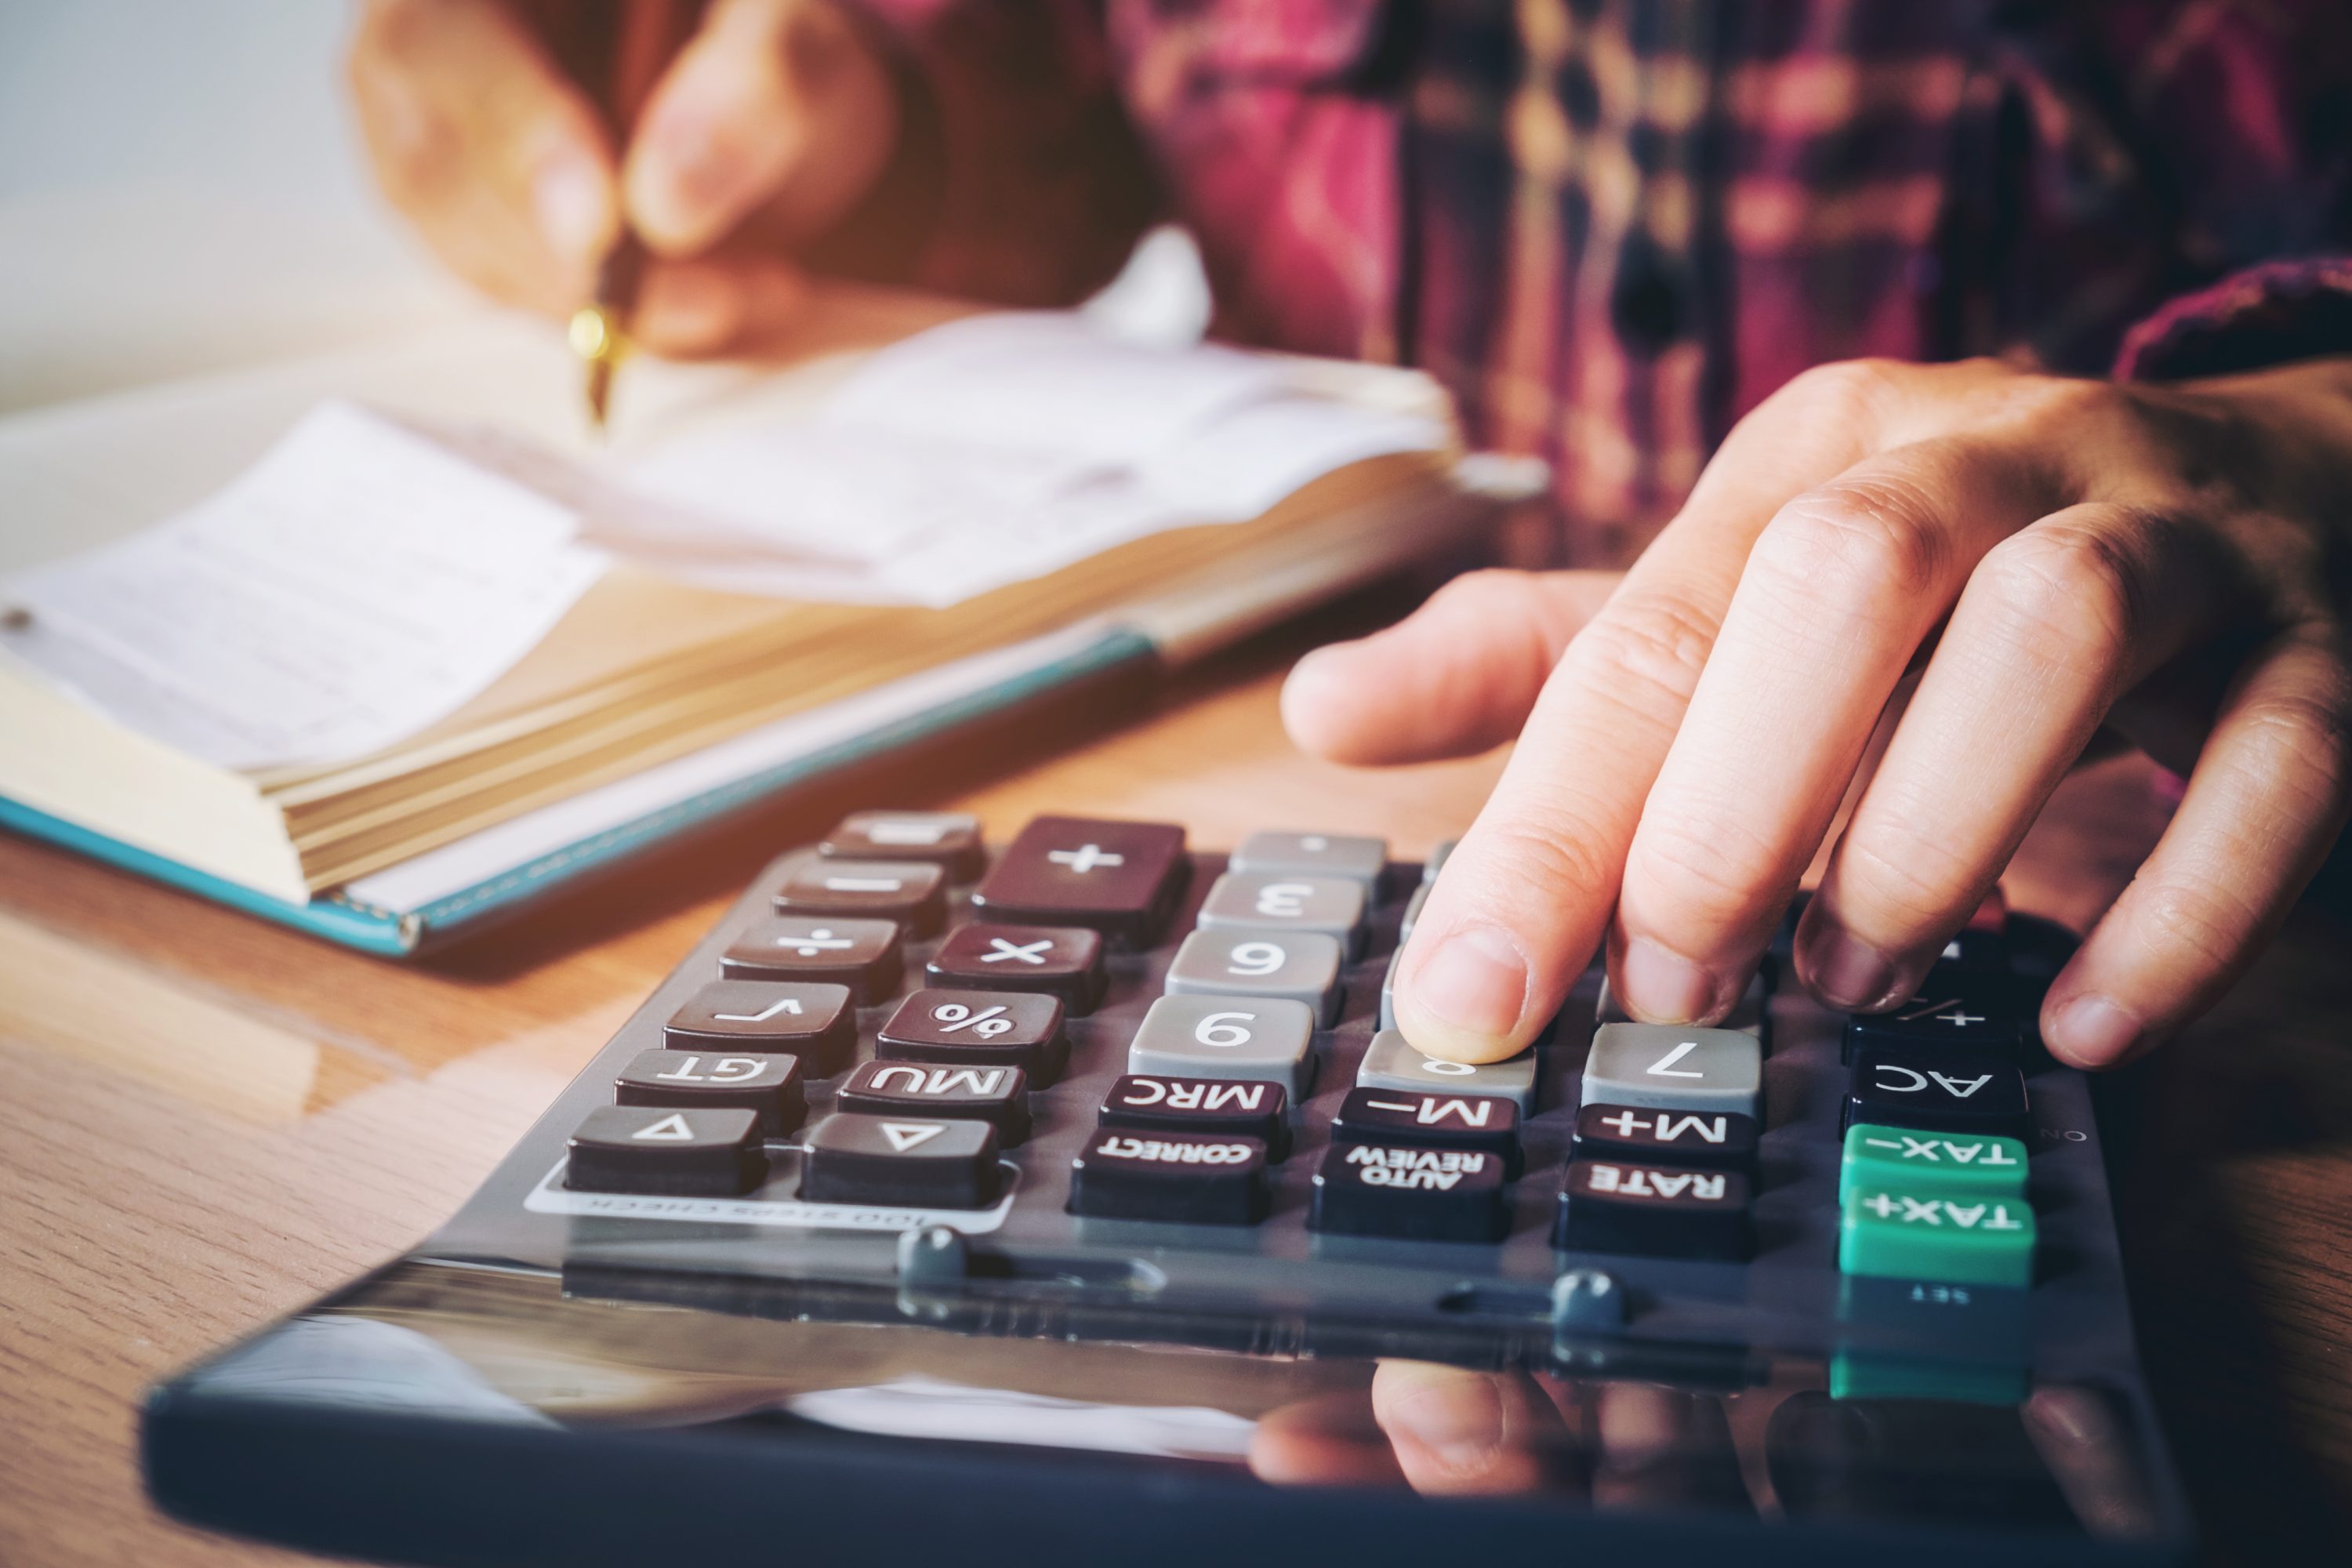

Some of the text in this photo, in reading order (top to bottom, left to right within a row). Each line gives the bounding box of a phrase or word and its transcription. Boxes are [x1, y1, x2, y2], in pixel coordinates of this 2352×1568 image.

[1256, 884, 1313, 916] 3
[1228, 942, 1286, 975] 6
[934, 1004, 1011, 1034] %
[1196, 1012, 1256, 1047] 9
[657, 1056, 768, 1081] GT
[1647, 1042, 1703, 1078] 7
[870, 1067, 1001, 1094] MU
[1123, 1080, 1265, 1109] MRC
[1875, 1065, 1993, 1097] AC
[1602, 1111, 1726, 1142] M+
[2041, 1128, 2087, 1142] ON
[1097, 1137, 1252, 1163] CORRECT
[1345, 1145, 1484, 1173] REVIEW
[1360, 1165, 1463, 1190] AUTO
[1588, 1164, 1726, 1200] RATE
[590, 1201, 717, 1214] CHECK
[1862, 1192, 2023, 1230] TAX+
[1911, 1285, 1970, 1304] SET
